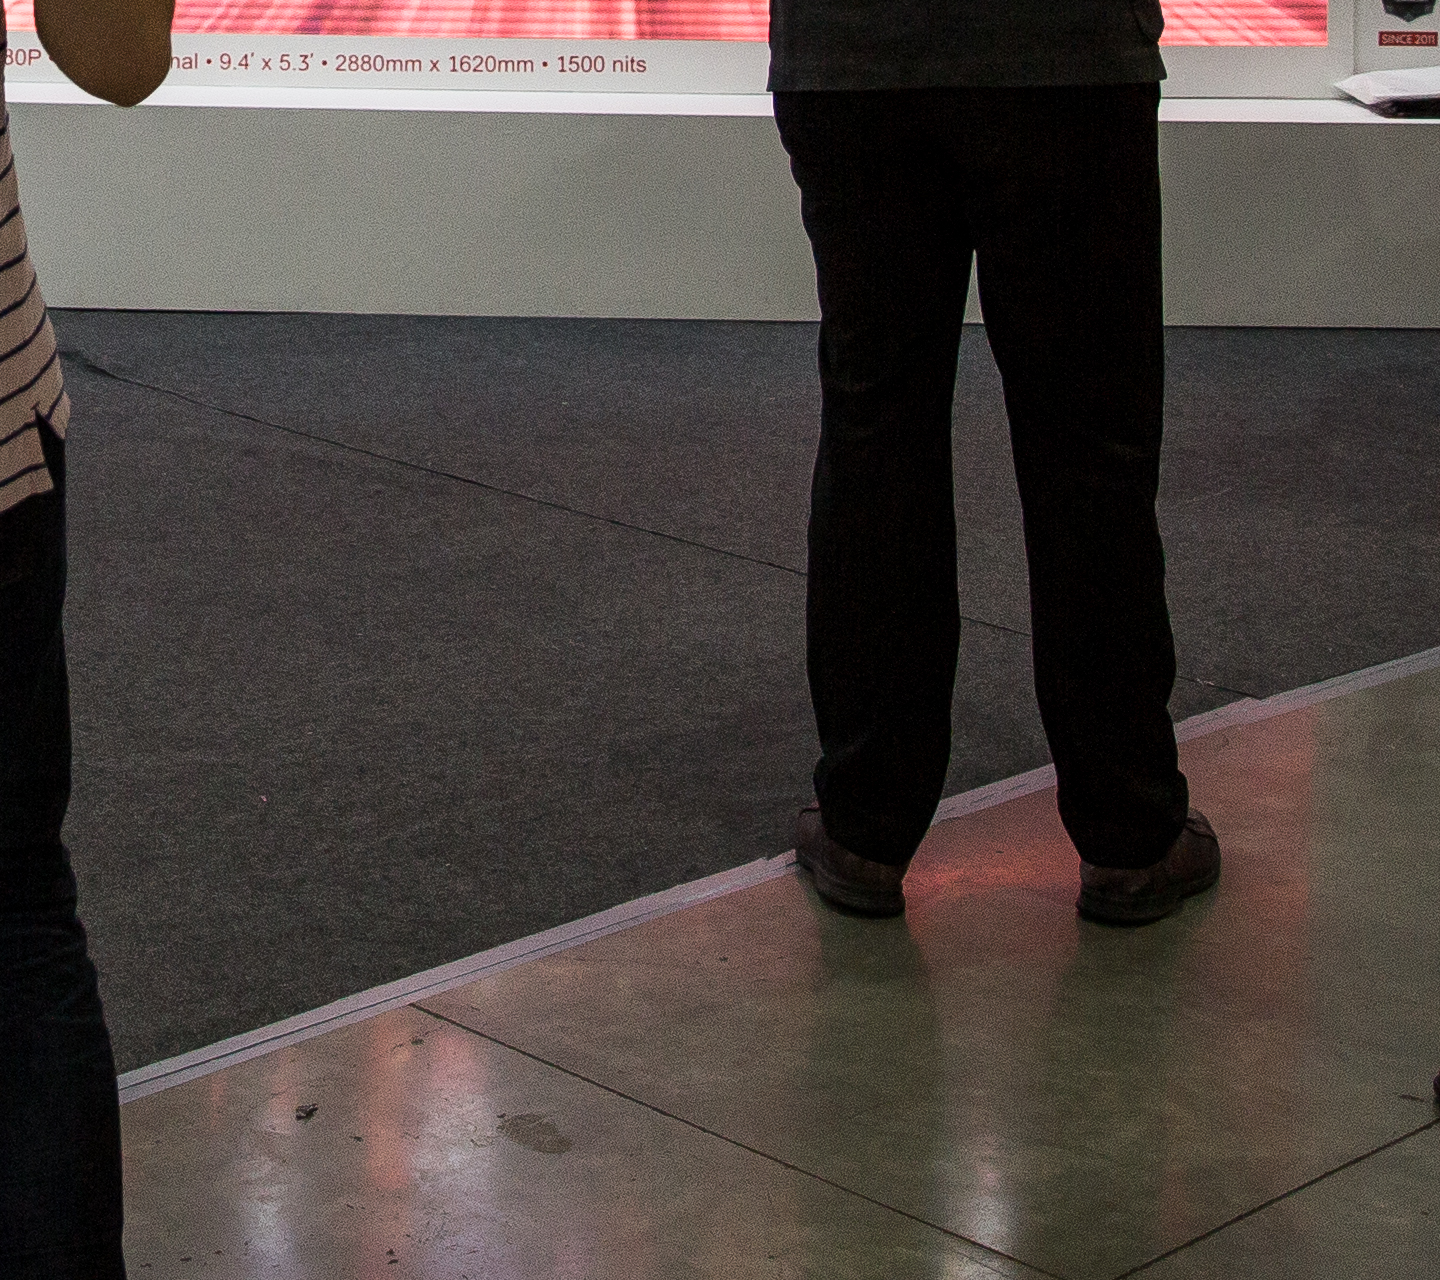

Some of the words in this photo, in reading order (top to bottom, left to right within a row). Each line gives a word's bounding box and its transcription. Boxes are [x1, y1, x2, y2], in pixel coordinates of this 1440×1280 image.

[335, 55, 422, 73] 2880mm
[449, 55, 535, 74] 1620mm
[557, 55, 606, 74] 1500
[613, 55, 647, 74] nits
